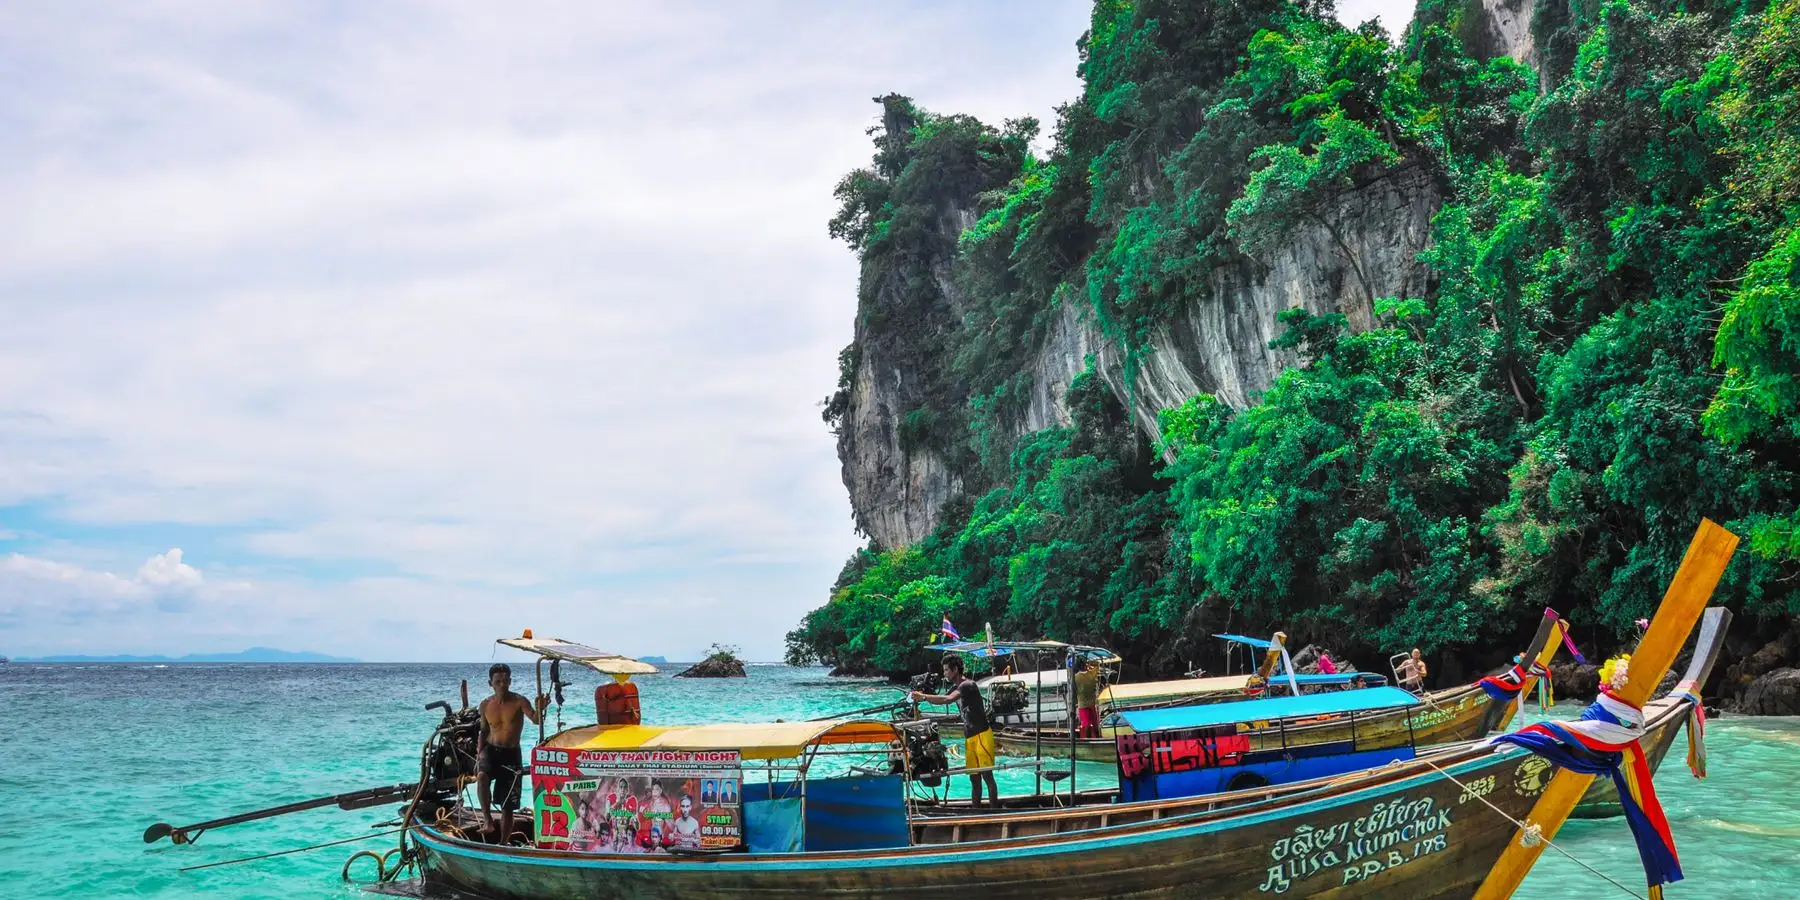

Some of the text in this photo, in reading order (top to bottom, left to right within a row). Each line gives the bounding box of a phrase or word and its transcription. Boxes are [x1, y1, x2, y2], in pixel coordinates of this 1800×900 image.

[535, 750, 569, 764] BIG
[582, 751, 738, 762] MUAY THAI FIGHT NIGHT
[535, 765, 570, 776] MATCH
[573, 781, 597, 790] PAIRS
[541, 810, 569, 837] 12
[706, 815, 732, 825] START
[701, 826, 724, 835] 09.00
[1259, 850, 1341, 894] Alisa
